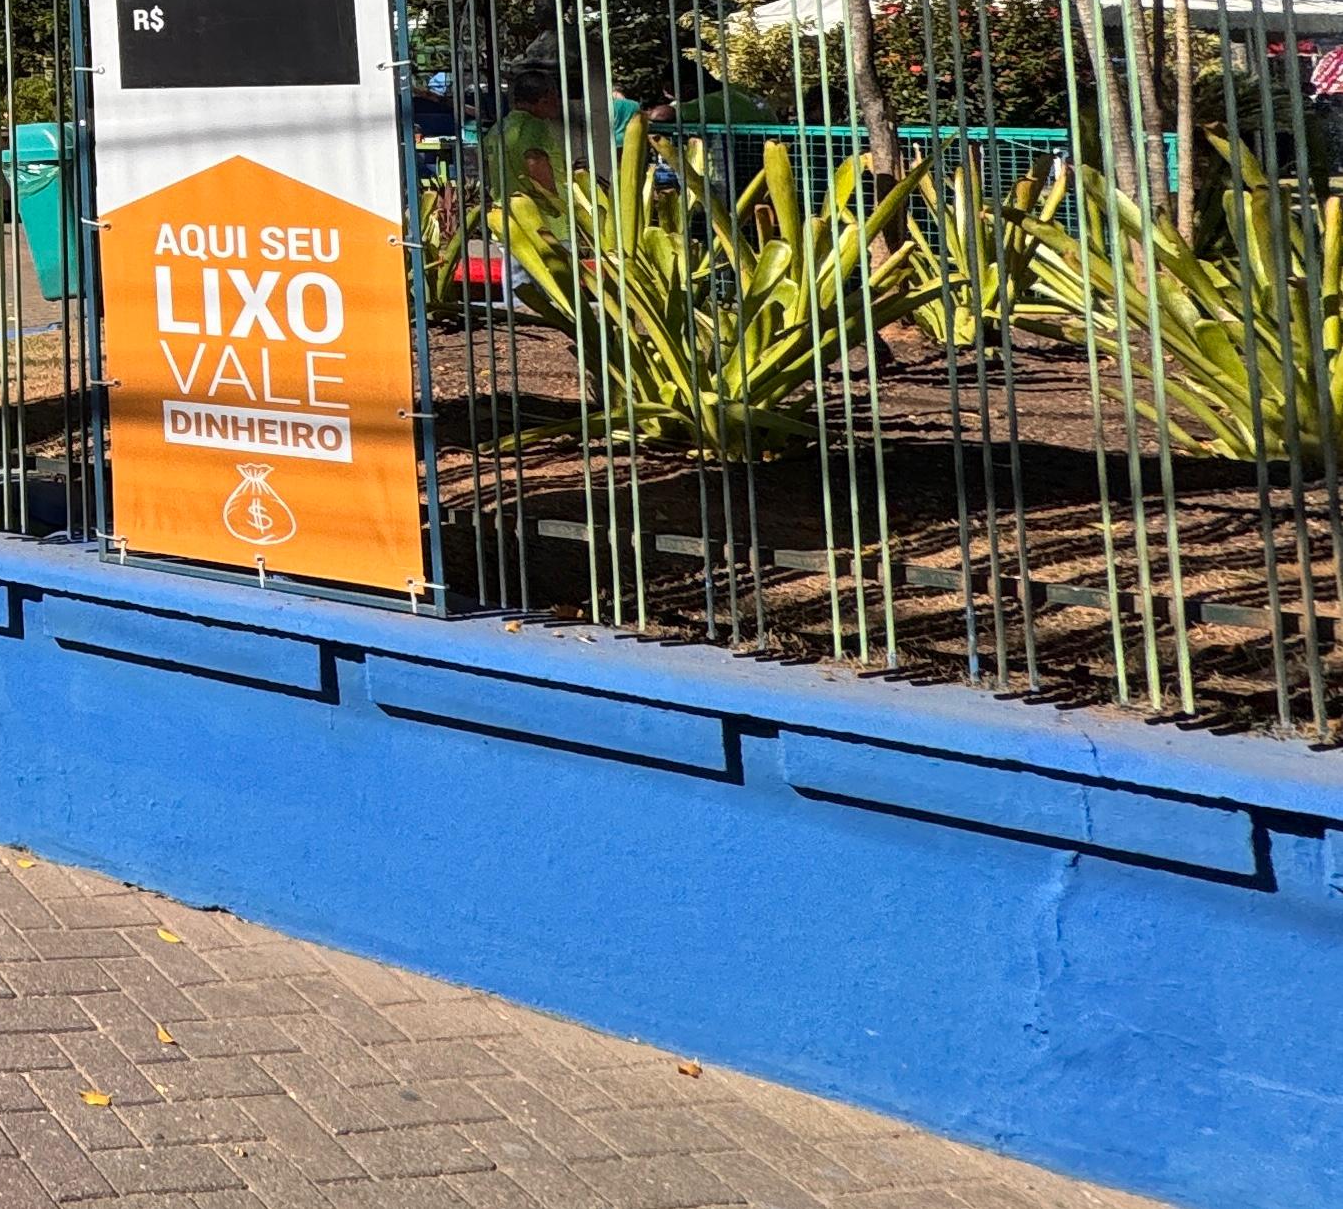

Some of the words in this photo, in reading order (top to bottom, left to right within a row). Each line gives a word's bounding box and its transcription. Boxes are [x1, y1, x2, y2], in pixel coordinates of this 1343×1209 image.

[133, 5, 164, 32] R$
[155, 223, 248, 261] AQUI
[259, 226, 340, 263] SEU
[155, 265, 344, 345] LIXO
[160, 339, 350, 409] VALE
[170, 408, 343, 452] DINHEIRO
